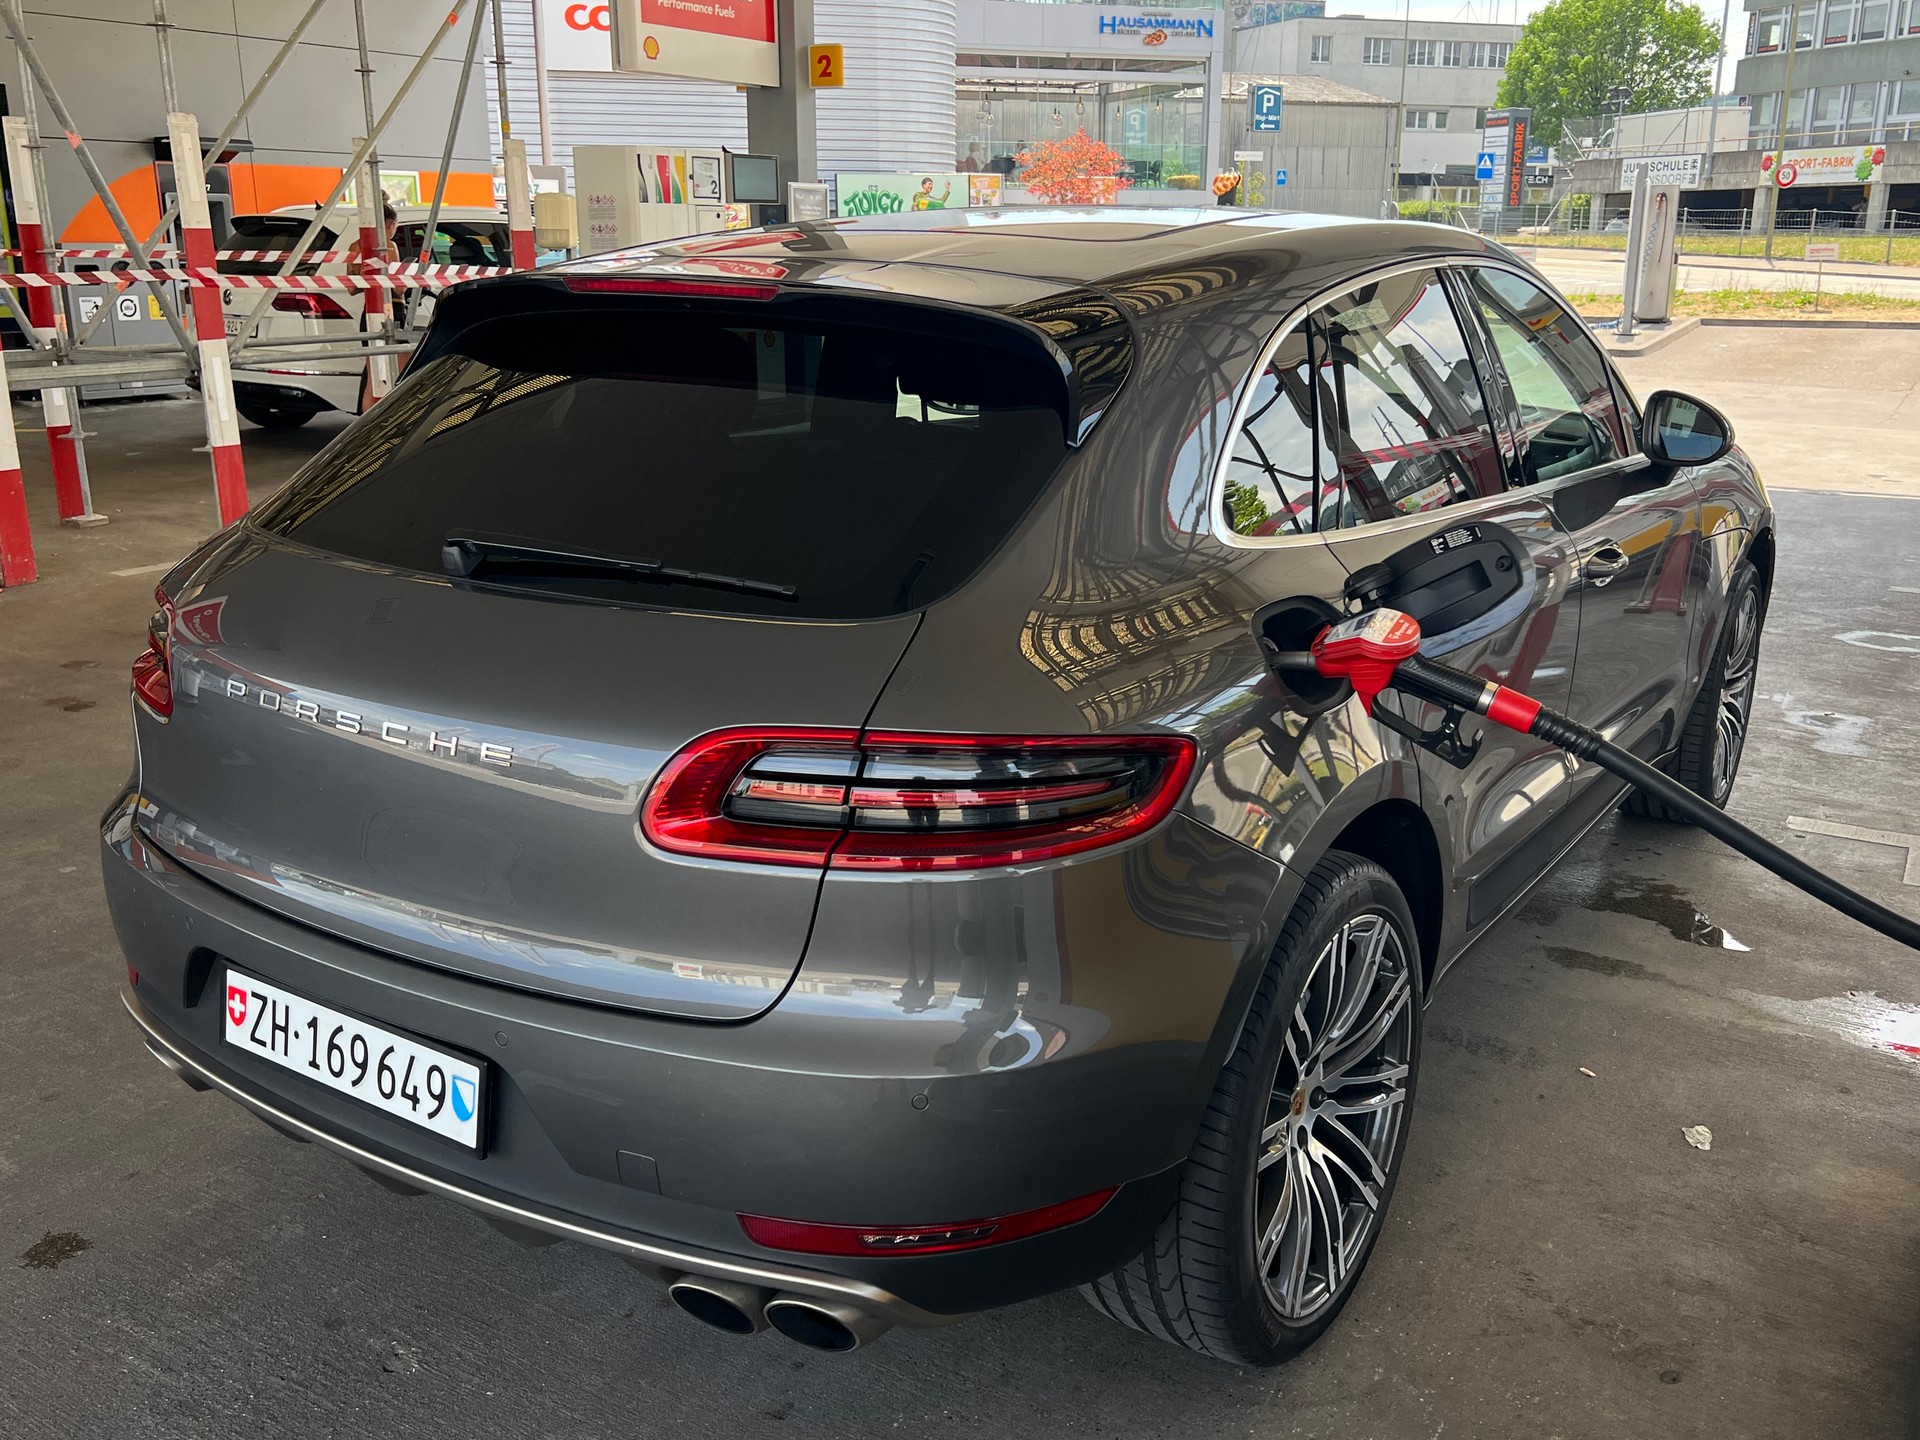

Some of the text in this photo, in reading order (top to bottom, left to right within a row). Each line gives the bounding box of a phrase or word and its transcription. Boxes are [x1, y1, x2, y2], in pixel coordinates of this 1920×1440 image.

[714, 4, 736, 19] Fuels
[1099, 15, 1214, 38] HAUSAMMANN
[817, 54, 833, 78] 2
[1263, 94, 1275, 113] P
[1510, 122, 1525, 206] SPORT-FABRIK
[1624, 160, 1689, 174] JUSCHULE
[1623, 173, 1688, 187] RENSDORF
[1781, 171, 1791, 180] 50
[710, 180, 718, 195] 2
[227, 678, 515, 768] PORSCHE
